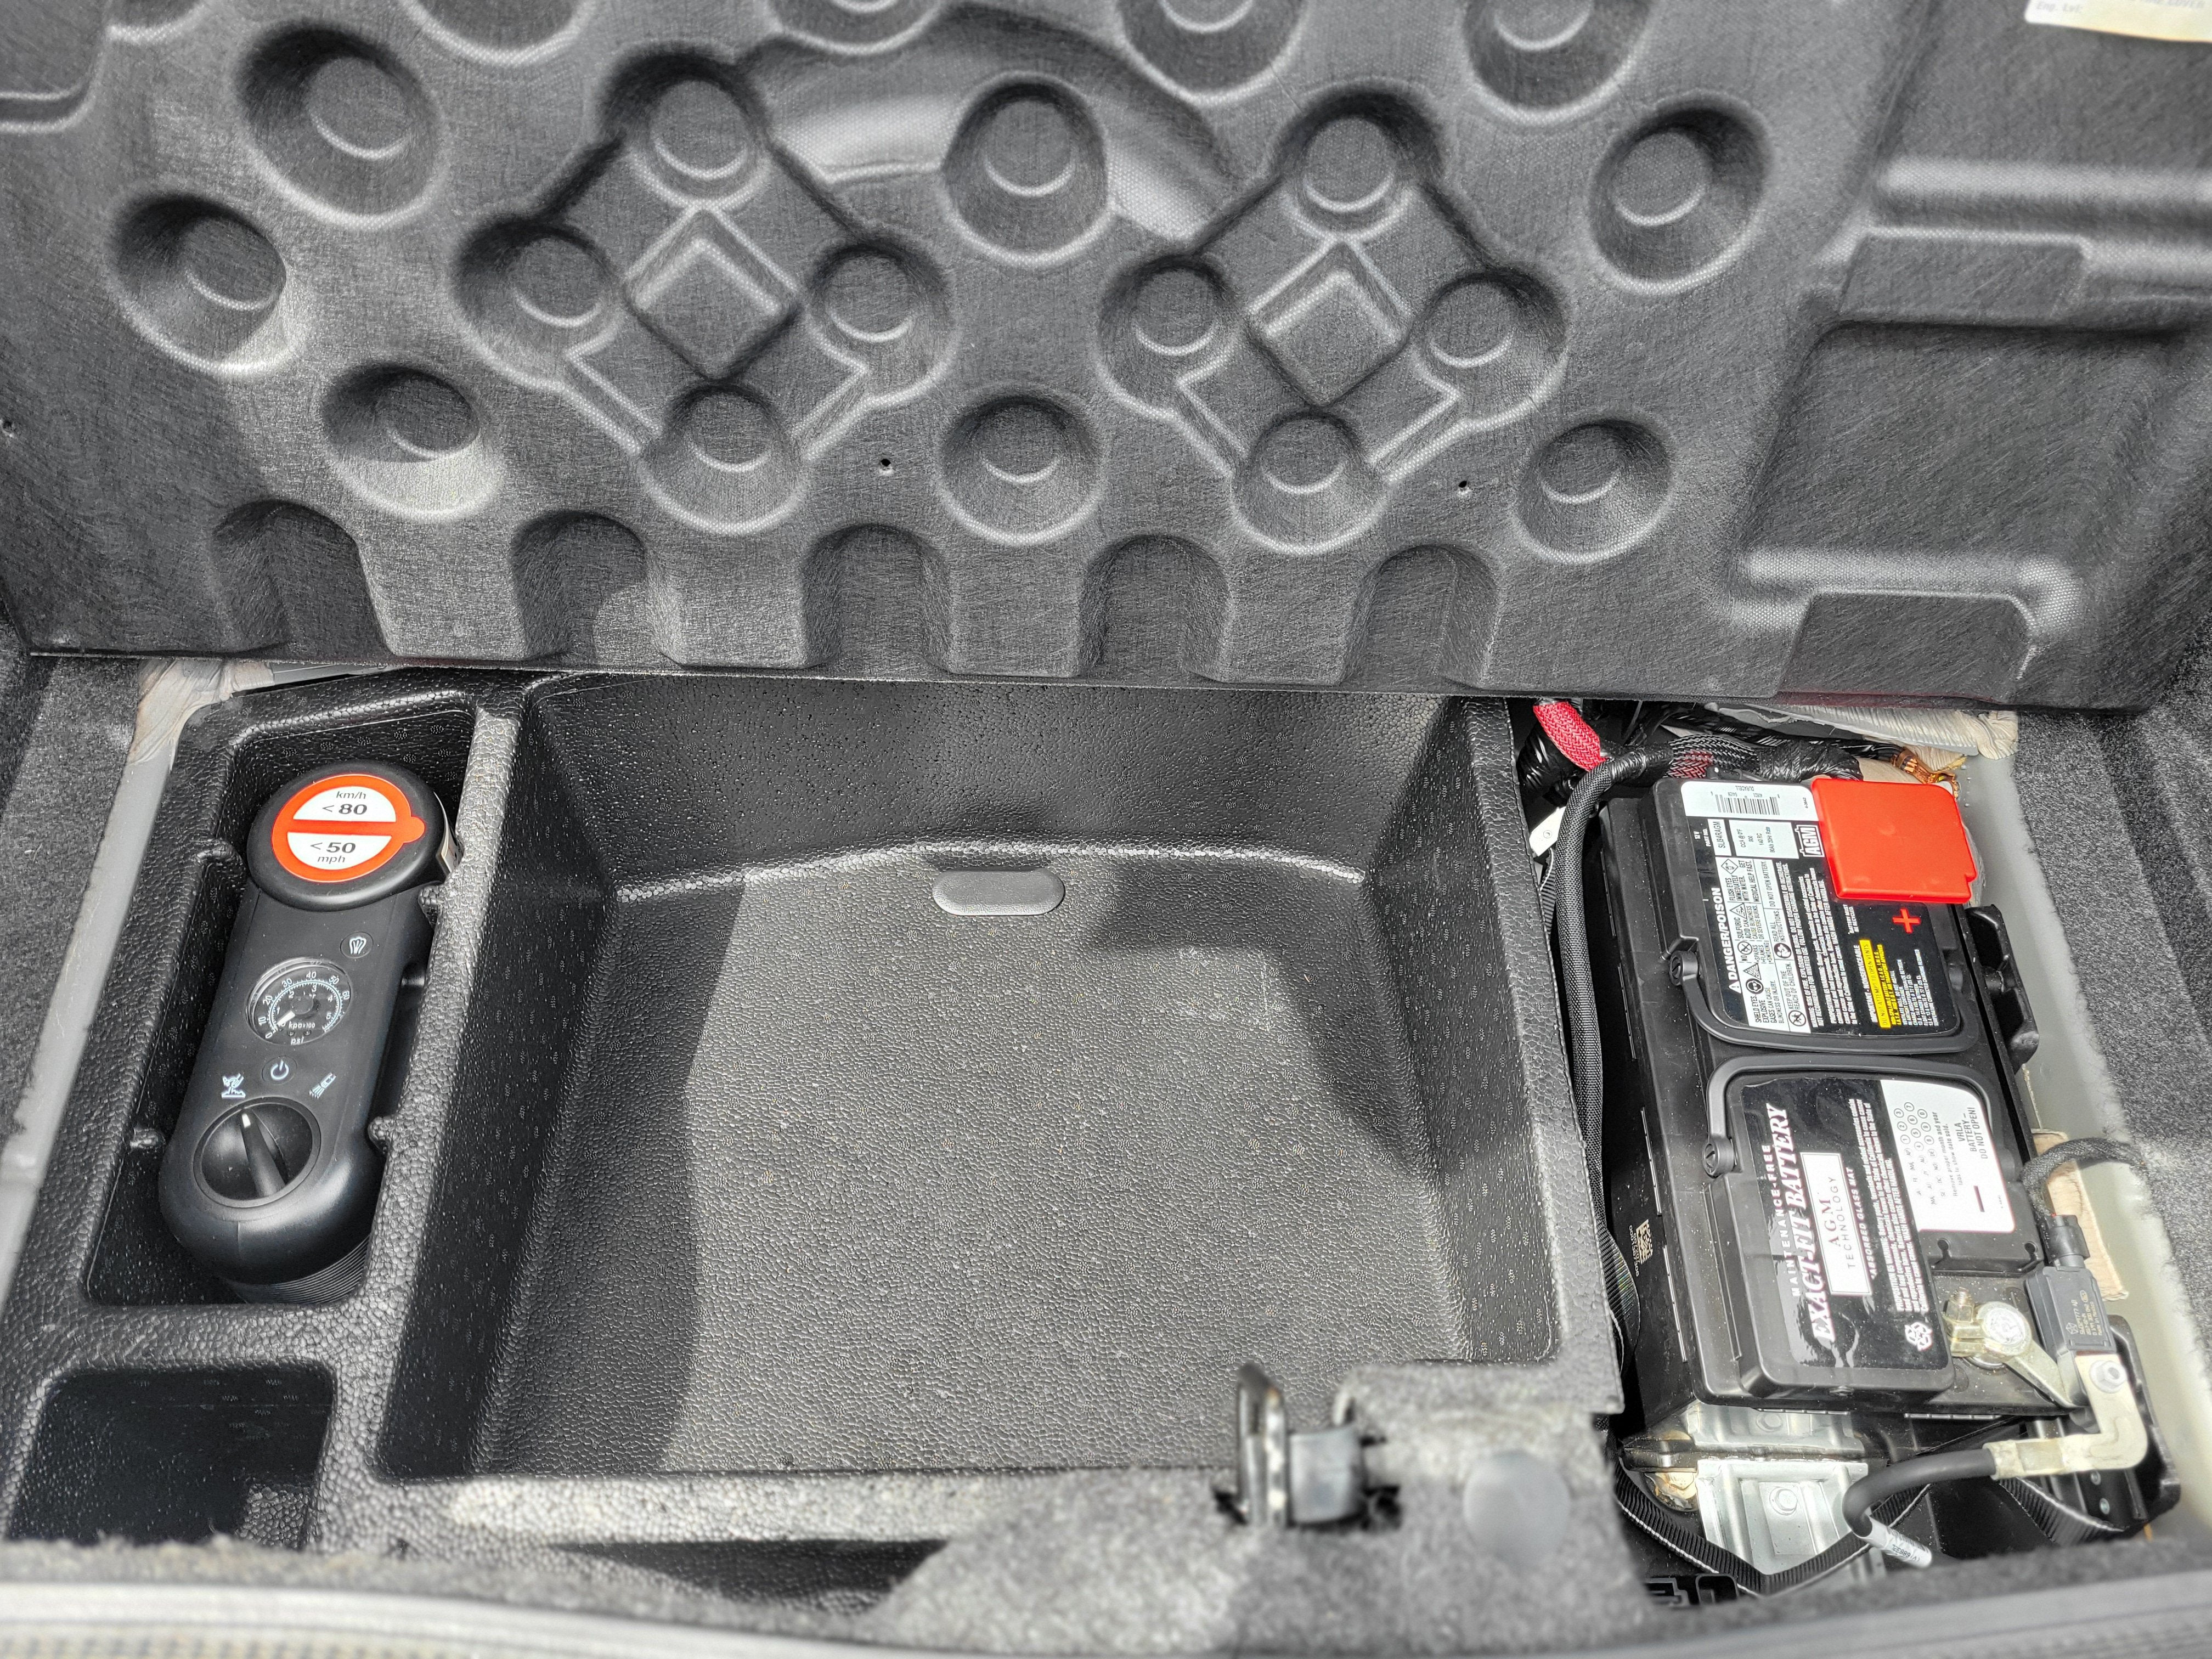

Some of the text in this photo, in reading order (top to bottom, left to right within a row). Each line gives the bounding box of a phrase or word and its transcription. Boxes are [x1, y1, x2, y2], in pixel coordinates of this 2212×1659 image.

[336, 791, 367, 799] km/h
[1799, 827, 1821, 854] AGM
[317, 855, 346, 864] mph
[1731, 874, 1742, 900] IMMEDIATELY
[1738, 876, 1747, 889] WATER.
[1727, 889, 1735, 900] FLUSH
[1750, 884, 1759, 902] MEDICAL
[1746, 906, 1755, 926] BLINDNESS
[1711, 887, 1739, 980] DANGER/POISON
[1734, 917, 1743, 938] SULFURIC
[1773, 909, 1786, 942] INSTRUCTIONS.
[329, 975, 340, 984] 50
[1785, 962, 1795, 986] CHILDREN.
[281, 978, 292, 988] 30
[1769, 980, 1778, 994] INJURY.
[263, 996, 273, 1005] 20
[342, 991, 349, 1000] 60
[1764, 987, 1772, 999] CAUSE
[1792, 995, 1801, 1009] REACH
[1752, 1008, 1762, 1022] SHIELD
[1758, 1000, 1769, 1022] EXPLOSIVE
[1769, 1009, 1777, 1023] GASES
[1774, 1002, 1784, 1023] BLINDNESS
[291, 1036, 304, 1046] psi
[1847, 1098, 1858, 1116] contain
[1855, 1099, 1865, 1115] cancer
[1859, 1116, 1869, 1130] cause
[1932, 1111, 1940, 1123] year
[1852, 1117, 1865, 1146] accessories
[1942, 1124, 1950, 1136] sold.
[1954, 1122, 1966, 1141] VRLA
[1962, 1120, 1977, 1151] BATTERY
[1973, 1131, 1985, 1146] NOT
[1864, 1137, 1876, 1160] California
[1938, 1136, 1946, 1153] month
[1858, 1147, 1869, 1164] related
[1949, 1152, 1957, 1165] show
[1978, 1148, 1988, 1159] DO
[1863, 1165, 1872, 1175] and
[1884, 1158, 1898, 1186] HANDLING.
[1943, 1155, 1953, 1172] proper
[1845, 1166, 1858, 1186] MAT
[1871, 1167, 1881, 1181] State
[1865, 1175, 1878, 1199] terminals
[1875, 1182, 1883, 1190] the
[1948, 1175, 1958, 1196] Remove
[1891, 1187, 1901, 1204] AFTER
[1850, 1189, 1865, 1220] GLASS
[1871, 1200, 1883, 1216] posts,
[1878, 1197, 1889, 1214] known
[1761, 1144, 1801, 1296] MAINTENANCE-FREE
[1765, 1103, 1836, 1342] EXACT-FIT BATTERY
[1827, 1176, 1857, 1268] TECHNOLOGY
[1895, 1205, 1906, 1223] HANDS
[1874, 1217, 1888, 1235] Battery
[1882, 1215, 1895, 1240] chemicals
[1900, 1224, 1911, 1240] WASH
[1879, 1237, 1893, 1263] WARNING:
[1889, 1242, 1904, 1273] compounds,
[1905, 1242, 1916, 1260] cancer.
[1910, 1262, 1920, 1277] cause
[1896, 1274, 1907, 1286] lead
[1888, 1273, 1905, 1311] PROPOSITION
[1899, 1287, 1909, 1297] and
[1915, 1285, 1929, 1311] California
[1902, 1299, 1913, 1311] lead
